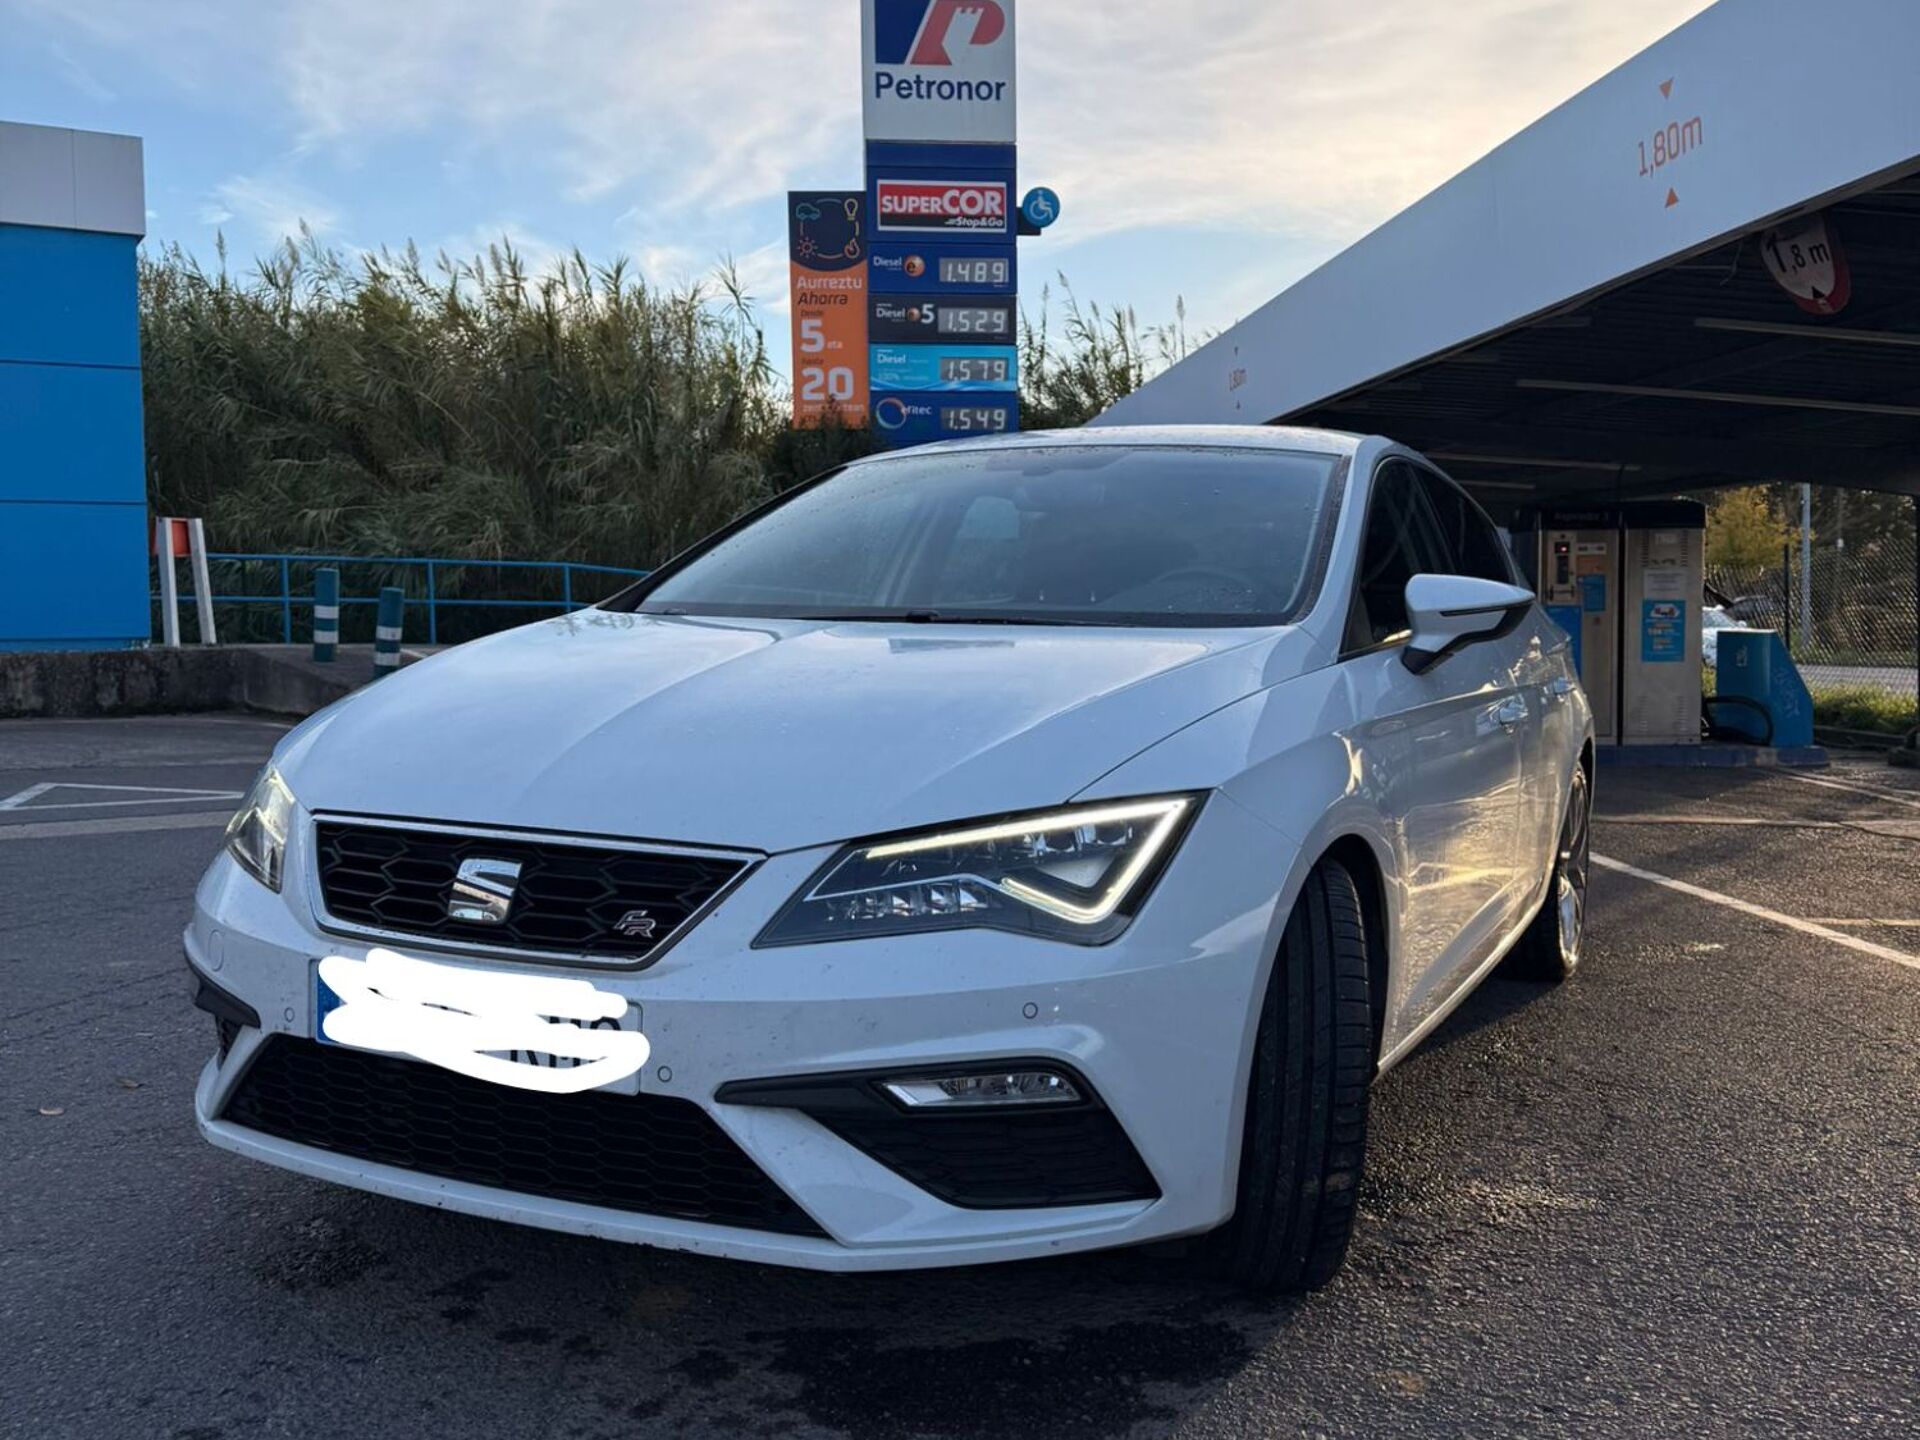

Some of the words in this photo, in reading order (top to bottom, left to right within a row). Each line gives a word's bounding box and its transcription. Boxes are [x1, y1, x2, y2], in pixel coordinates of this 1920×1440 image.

[874, 71, 1006, 101] Petronor
[1637, 115, 1703, 178] 1,80m
[880, 189, 1003, 215] SUPERCOR
[873, 255, 903, 267] Diesel
[796, 275, 863, 290] Aurreztu
[947, 262, 1004, 283] 1.489
[797, 291, 849, 306] Ahorra
[876, 308, 906, 319] Diesel
[920, 303, 935, 325] 5
[947, 311, 1005, 333] 1.529
[800, 318, 825, 354] 5
[876, 353, 907, 364] Diesel
[948, 360, 1006, 382] 1.579
[801, 366, 854, 401] 20
[948, 409, 1006, 431] 1.549
